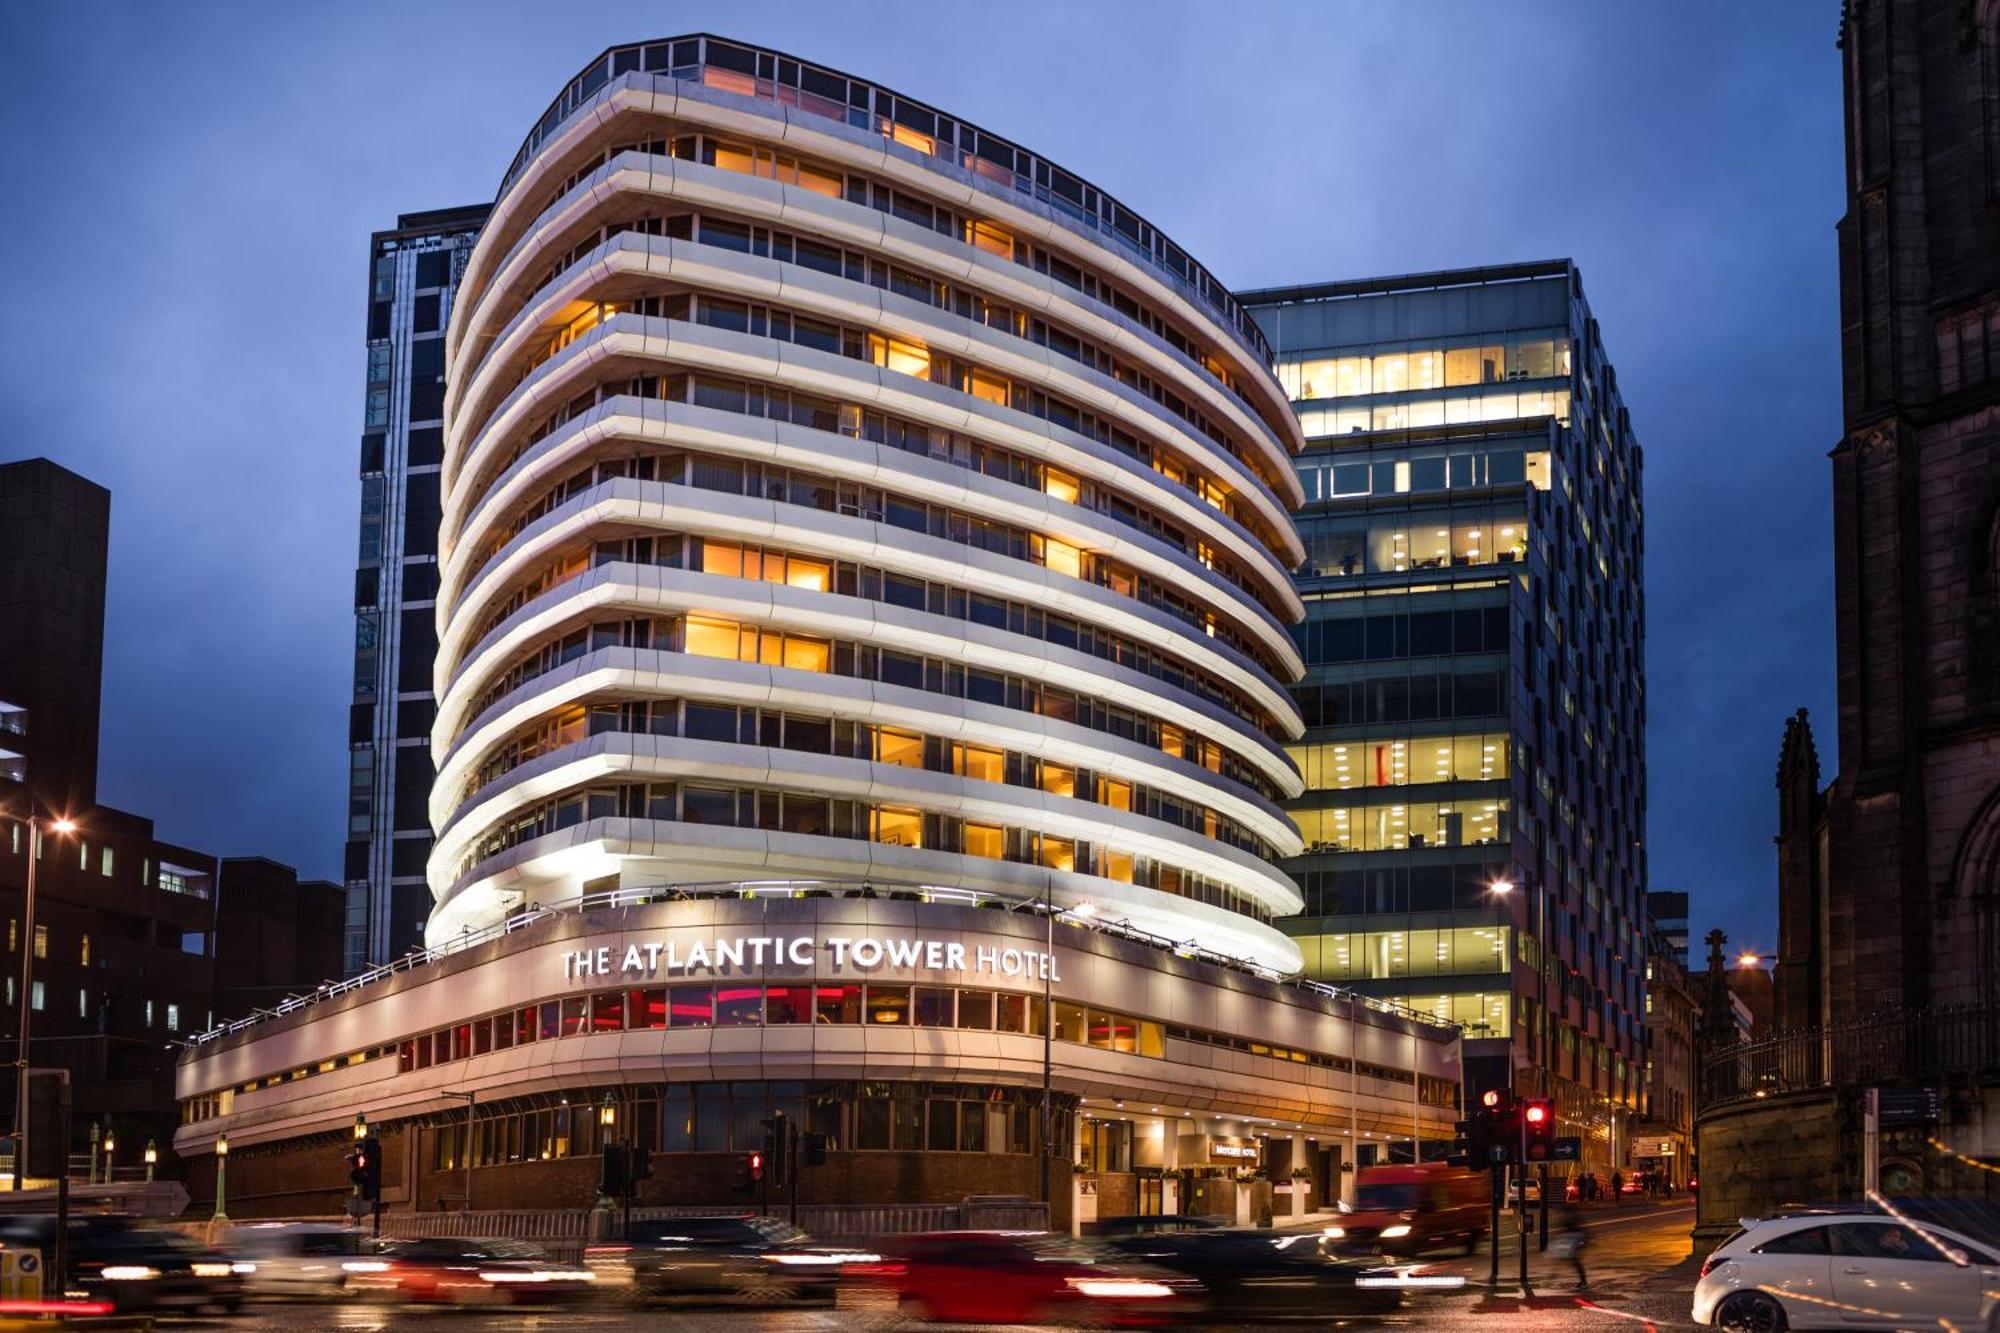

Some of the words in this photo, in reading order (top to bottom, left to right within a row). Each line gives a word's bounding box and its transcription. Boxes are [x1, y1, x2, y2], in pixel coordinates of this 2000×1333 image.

[560, 946, 611, 979] THE
[621, 937, 815, 972] ATLANTIC
[828, 937, 968, 970] TOWER
[976, 944, 1061, 982] HOTEL
